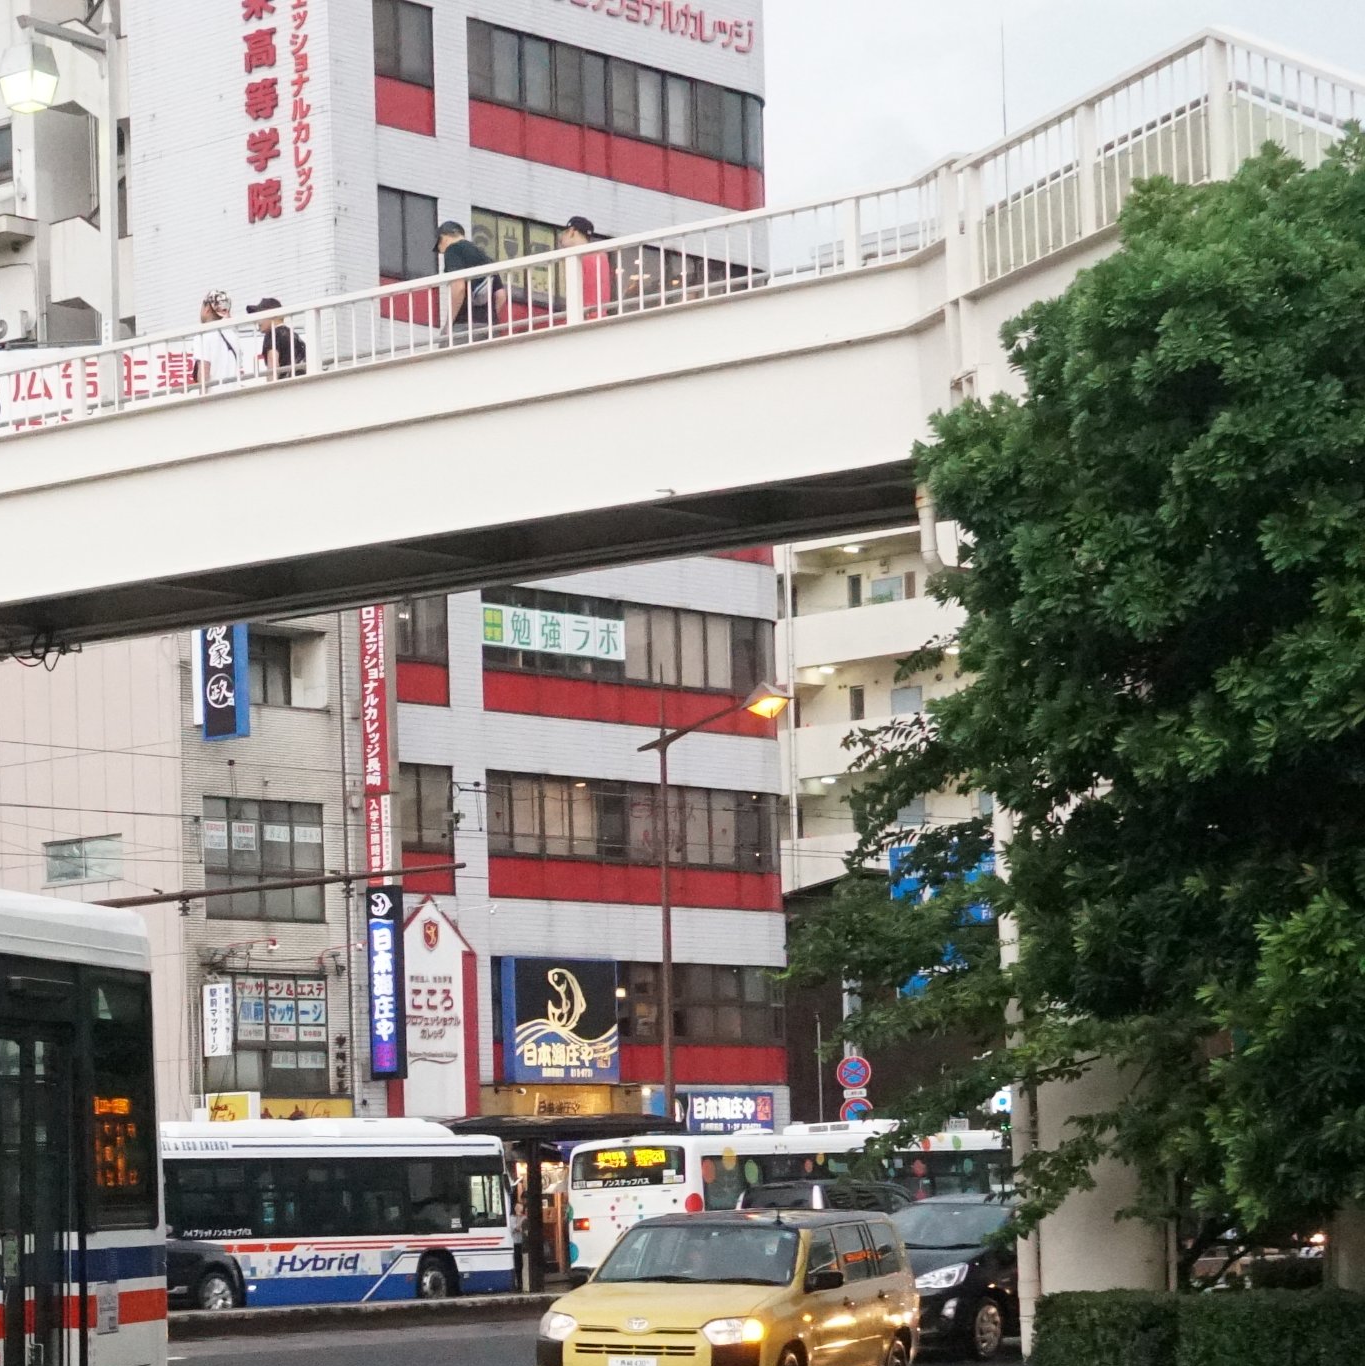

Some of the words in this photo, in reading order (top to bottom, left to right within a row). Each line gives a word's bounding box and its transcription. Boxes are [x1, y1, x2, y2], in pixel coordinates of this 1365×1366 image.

[511, 610, 618, 655] 勉強ラボ
[412, 988, 454, 1011] こころ
[604, 1177, 650, 1187] ノンステップバス
[277, 1253, 360, 1272] Hybrid
